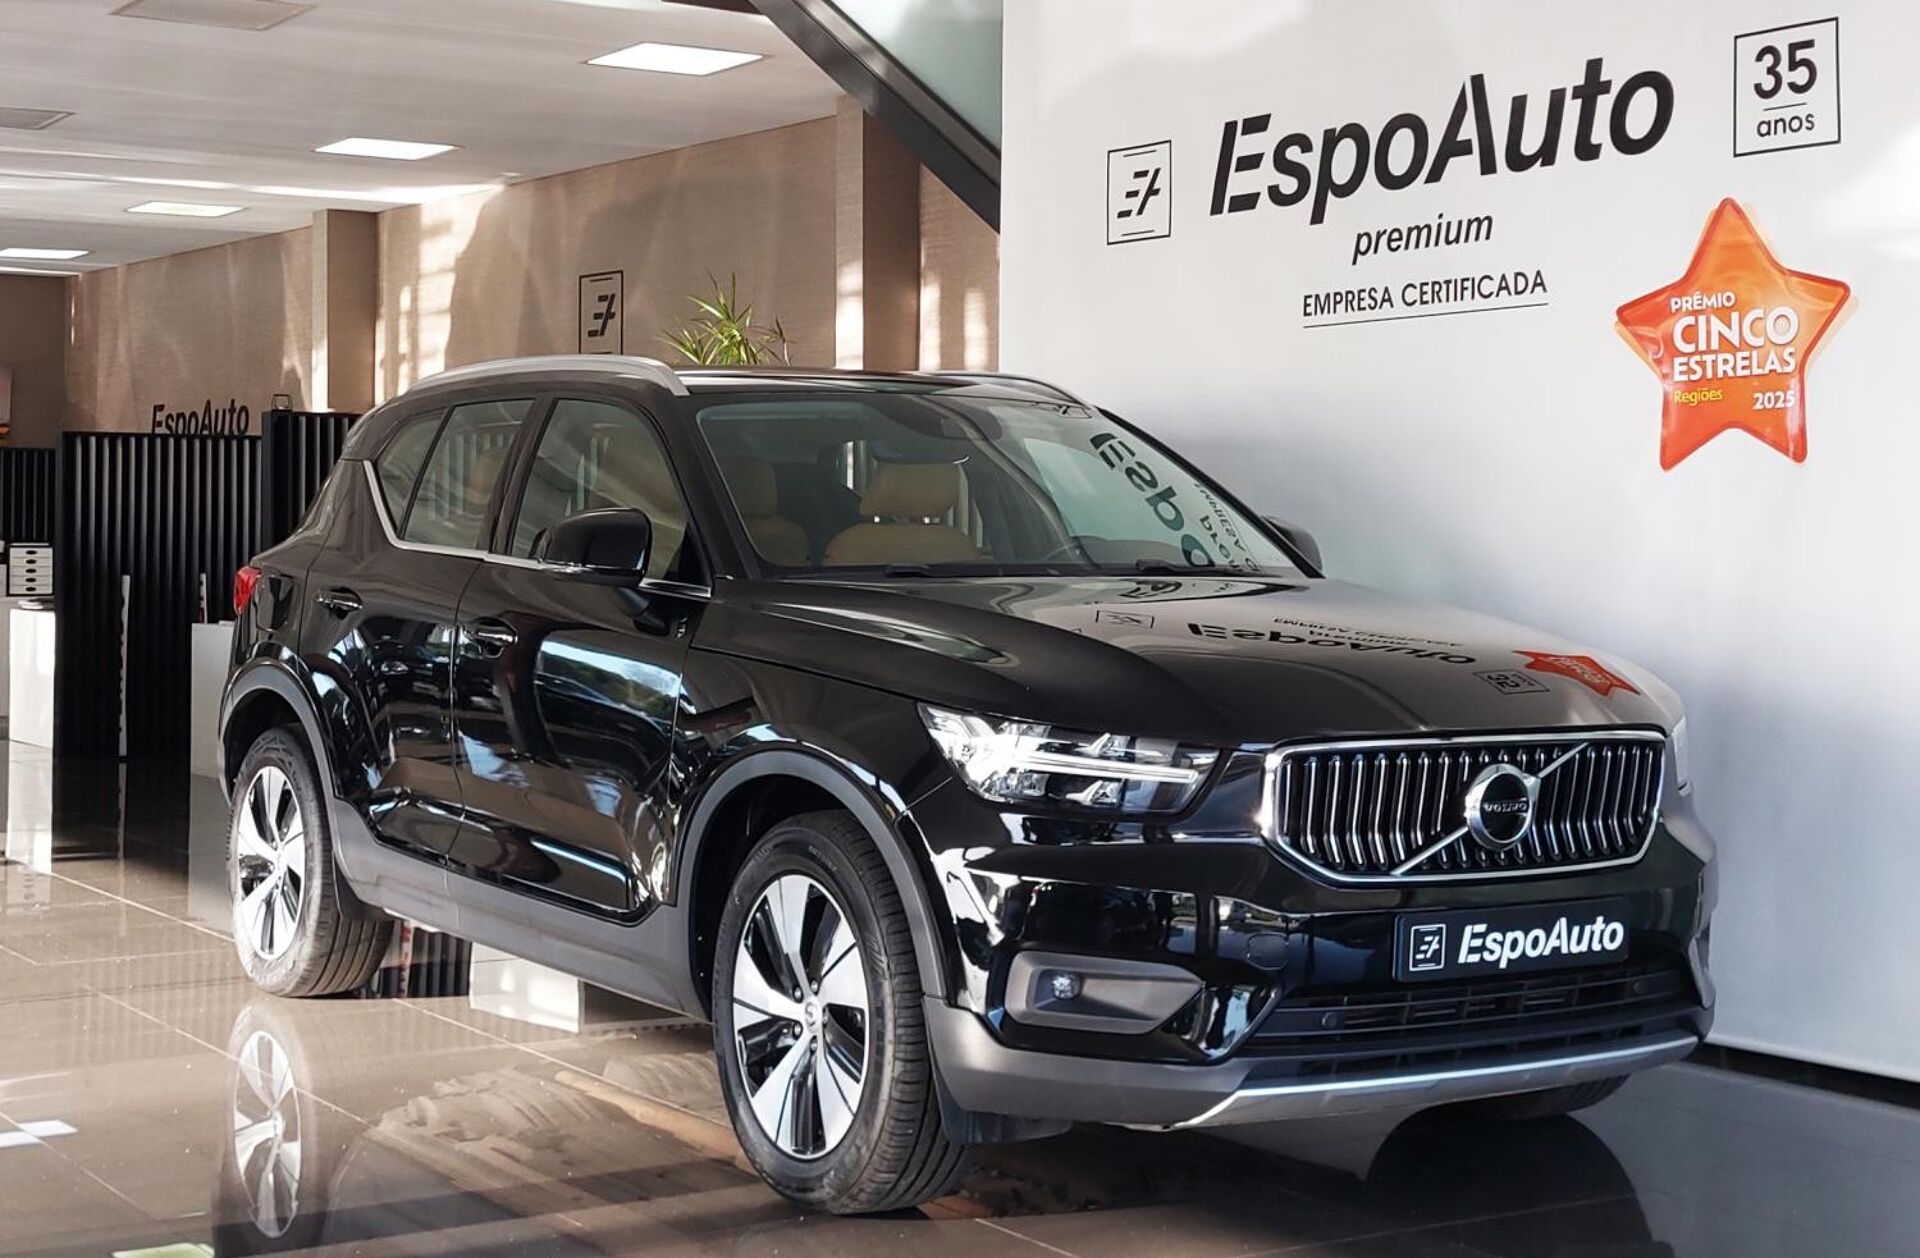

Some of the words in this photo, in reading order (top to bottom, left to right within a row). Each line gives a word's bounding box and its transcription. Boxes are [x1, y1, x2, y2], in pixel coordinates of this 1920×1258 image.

[1754, 38, 1817, 99] 35
[1210, 57, 1675, 225] EspoAuto
[1757, 113, 1815, 137] anos
[1352, 213, 1493, 266] premium
[1303, 286, 1394, 317] EMPRESA
[1401, 270, 1547, 307] CERTIFICADA
[1673, 306, 1798, 353] CINCO
[1673, 348, 1796, 382] ESTRELAS
[1674, 387, 1723, 406] Regiões
[1752, 390, 1795, 410] 2025
[1483, 803, 1528, 812] VOLVO
[1457, 916, 1624, 969] EspoAuto
